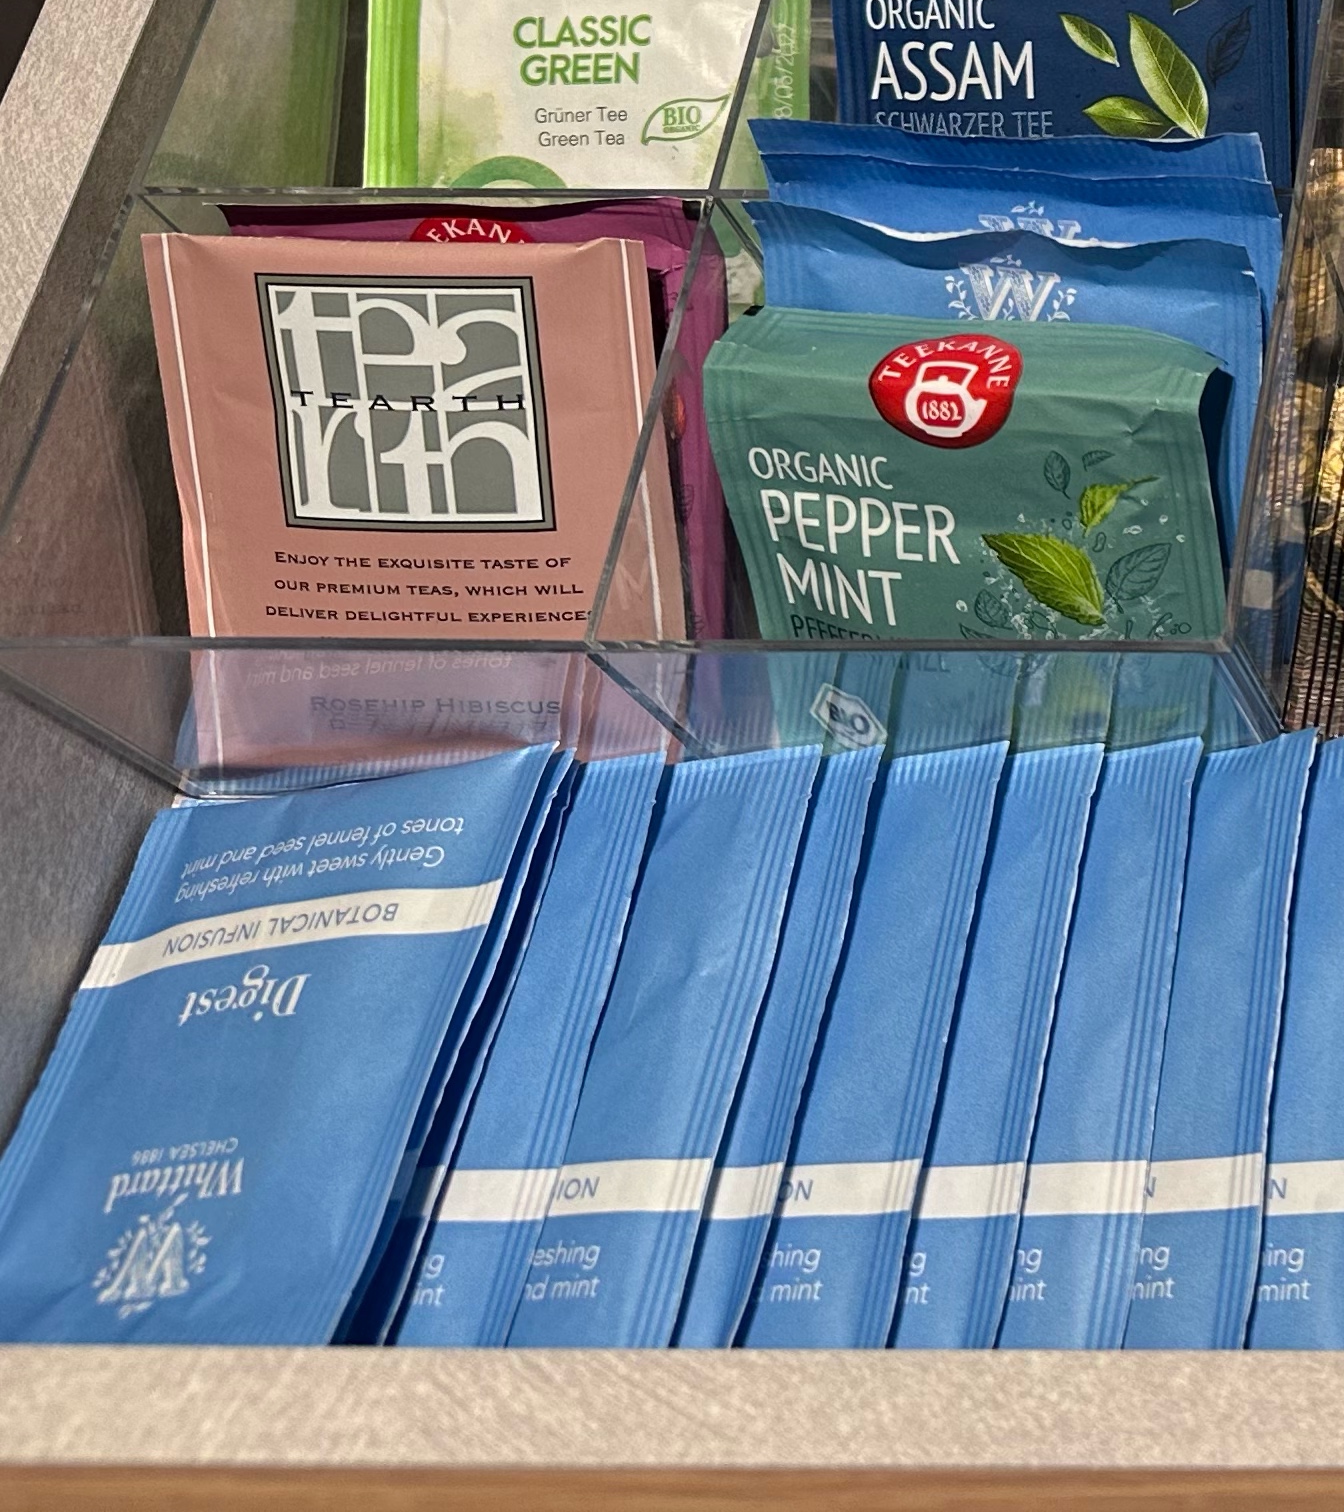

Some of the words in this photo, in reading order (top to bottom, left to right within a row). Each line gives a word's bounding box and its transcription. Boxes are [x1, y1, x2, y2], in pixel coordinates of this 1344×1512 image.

[513, 14, 654, 48] CLASSIC
[520, 50, 640, 87] GREEN
[870, 40, 1036, 102] ASSAM
[534, 105, 592, 124] Grüner
[596, 107, 628, 124] Tee
[663, 104, 702, 126] BIO
[874, 111, 1006, 140] SCHWARZER
[1011, 111, 1054, 139] TEE
[538, 130, 589, 148] Green
[594, 130, 626, 147] Tea
[877, 338, 1011, 390] TEEKANNE
[291, 389, 527, 413] TEARTH
[921, 399, 964, 422] 1882
[747, 446, 895, 491] ORGANIC
[760, 488, 962, 566] PEPPER
[335, 555, 372, 568] THE
[377, 556, 476, 571] EXQUISITE
[479, 557, 539, 570] TASTE
[544, 557, 572, 569] OF
[273, 579, 311, 592] OUR
[316, 582, 401, 596] PREMIUM
[405, 584, 460, 598] TEAS,
[464, 584, 528, 596] WHICH
[533, 582, 585, 595] WILL
[776, 552, 904, 628] MINT
[265, 605, 339, 621] DELIVER
[344, 608, 463, 623] DELIGHTFUL
[309, 695, 426, 714] ROSEHIP
[435, 697, 561, 716] HIBISCUS
[268, 903, 400, 936] BOTANICAL
[161, 920, 262, 958] INFUSION
[178, 964, 312, 1027] Digest
[170, 1137, 239, 1158] CHELSEA
[104, 1157, 245, 1215] Whittard
